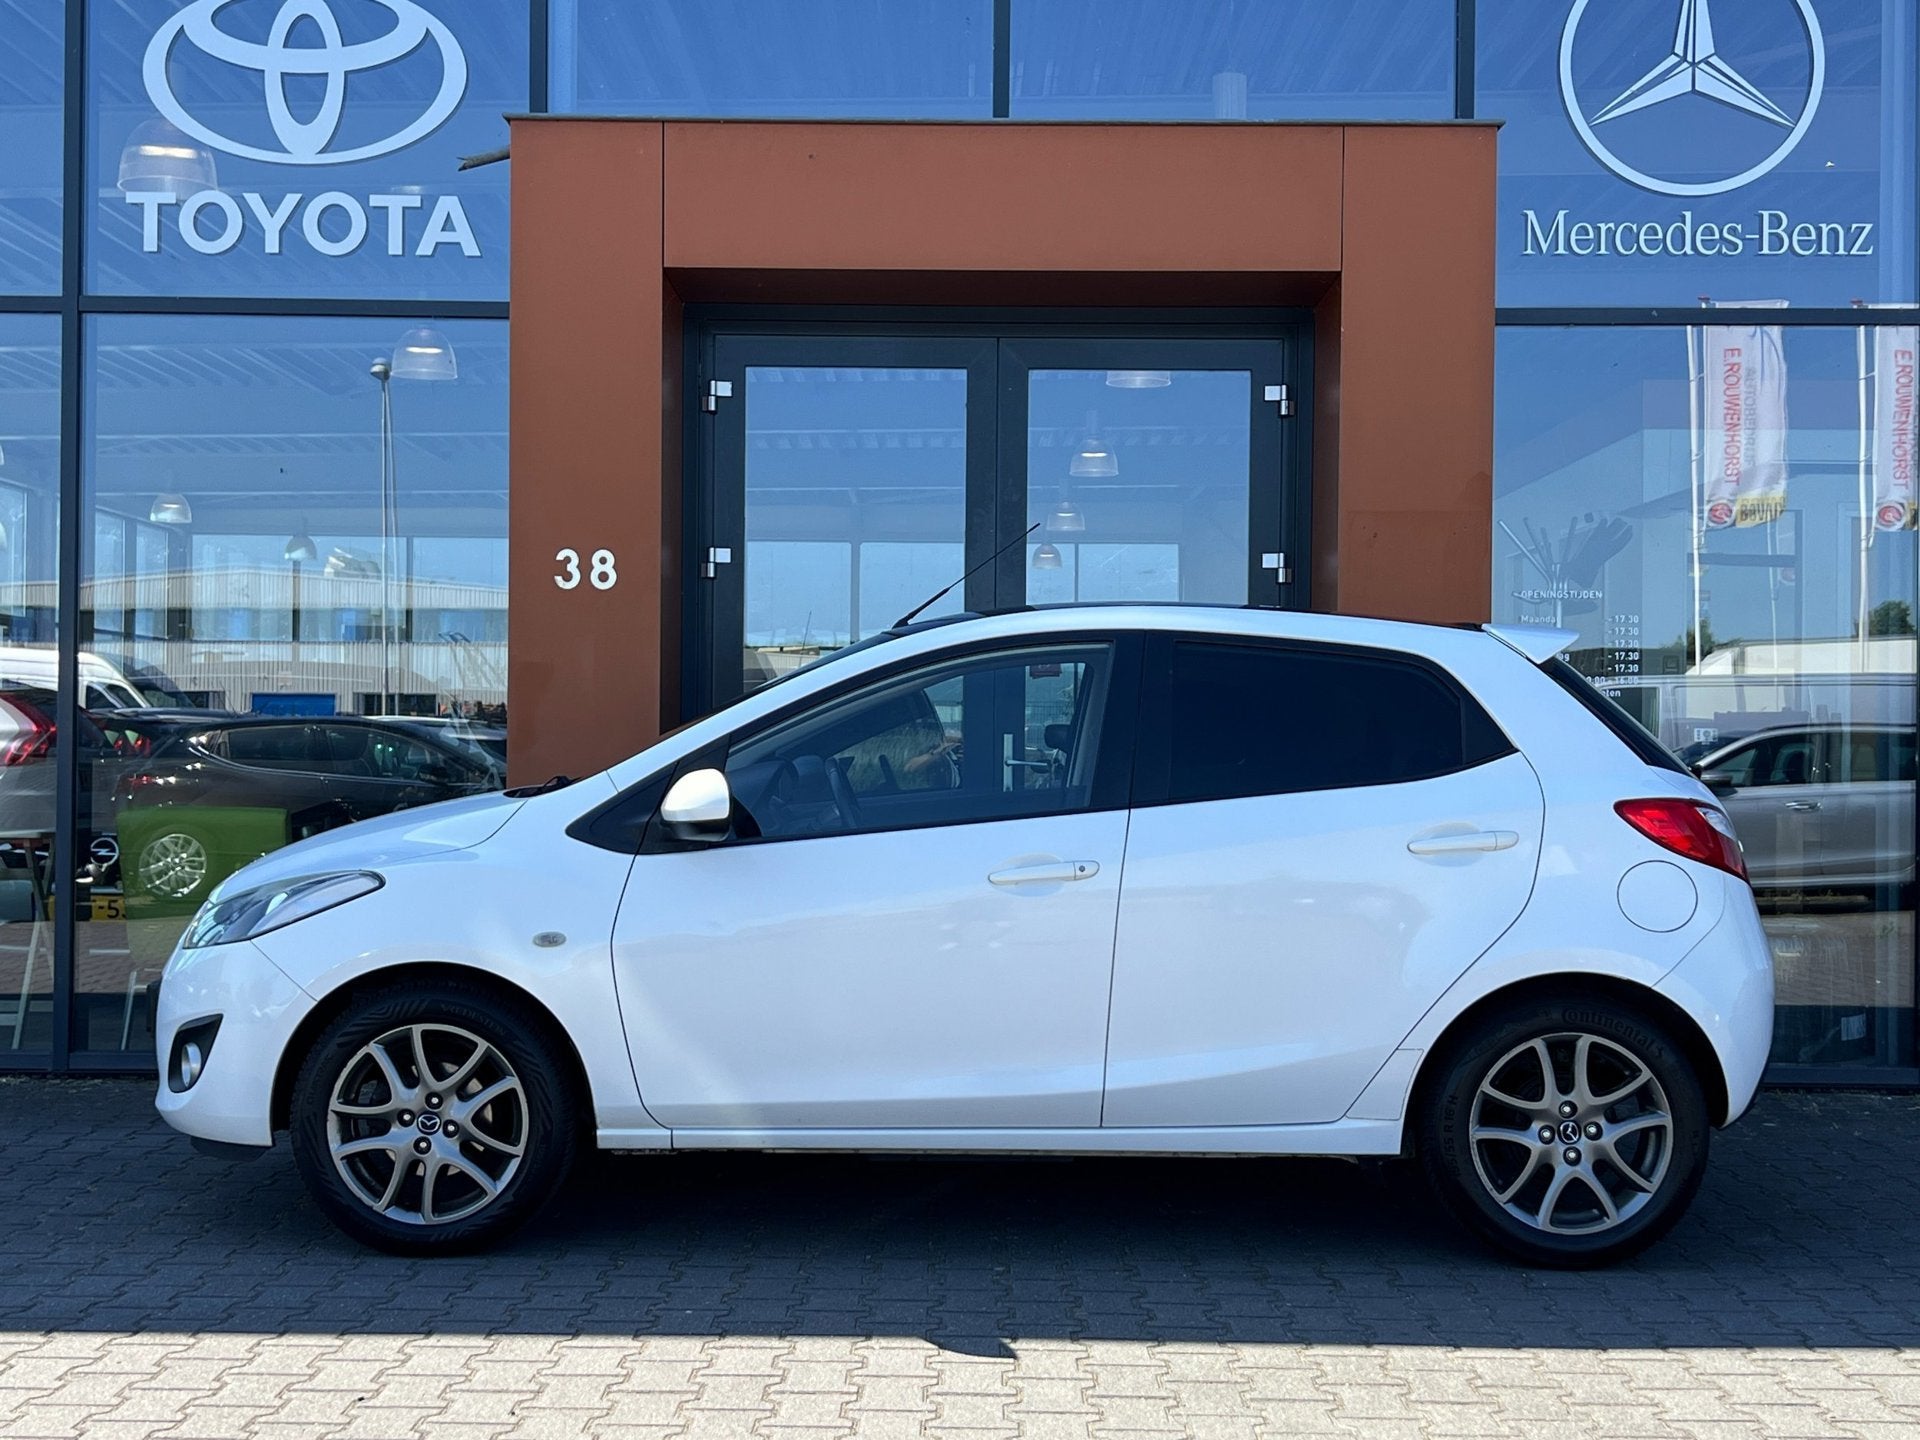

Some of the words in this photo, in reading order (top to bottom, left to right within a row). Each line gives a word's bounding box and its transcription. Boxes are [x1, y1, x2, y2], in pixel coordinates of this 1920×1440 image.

[125, 189, 482, 257] TOYOTA
[1523, 209, 1874, 257] Mercedes-Benz
[1723, 347, 1742, 486] E.ROUWENHORST
[1892, 349, 1914, 489] E.ROUWENHORST
[554, 548, 617, 590] 38
[1521, 590, 1603, 599] OPENINGSTIJDEN
[1521, 615, 1561, 624] Maanda
[1614, 615, 1639, 624] 17.30
[1614, 627, 1639, 636] 17.30
[1614, 639, 1639, 648] 17.30
[1614, 652, 1639, 661] 17.30
[1614, 664, 1639, 673] 17.30
[1561, 1007, 1655, 1051] Continental
